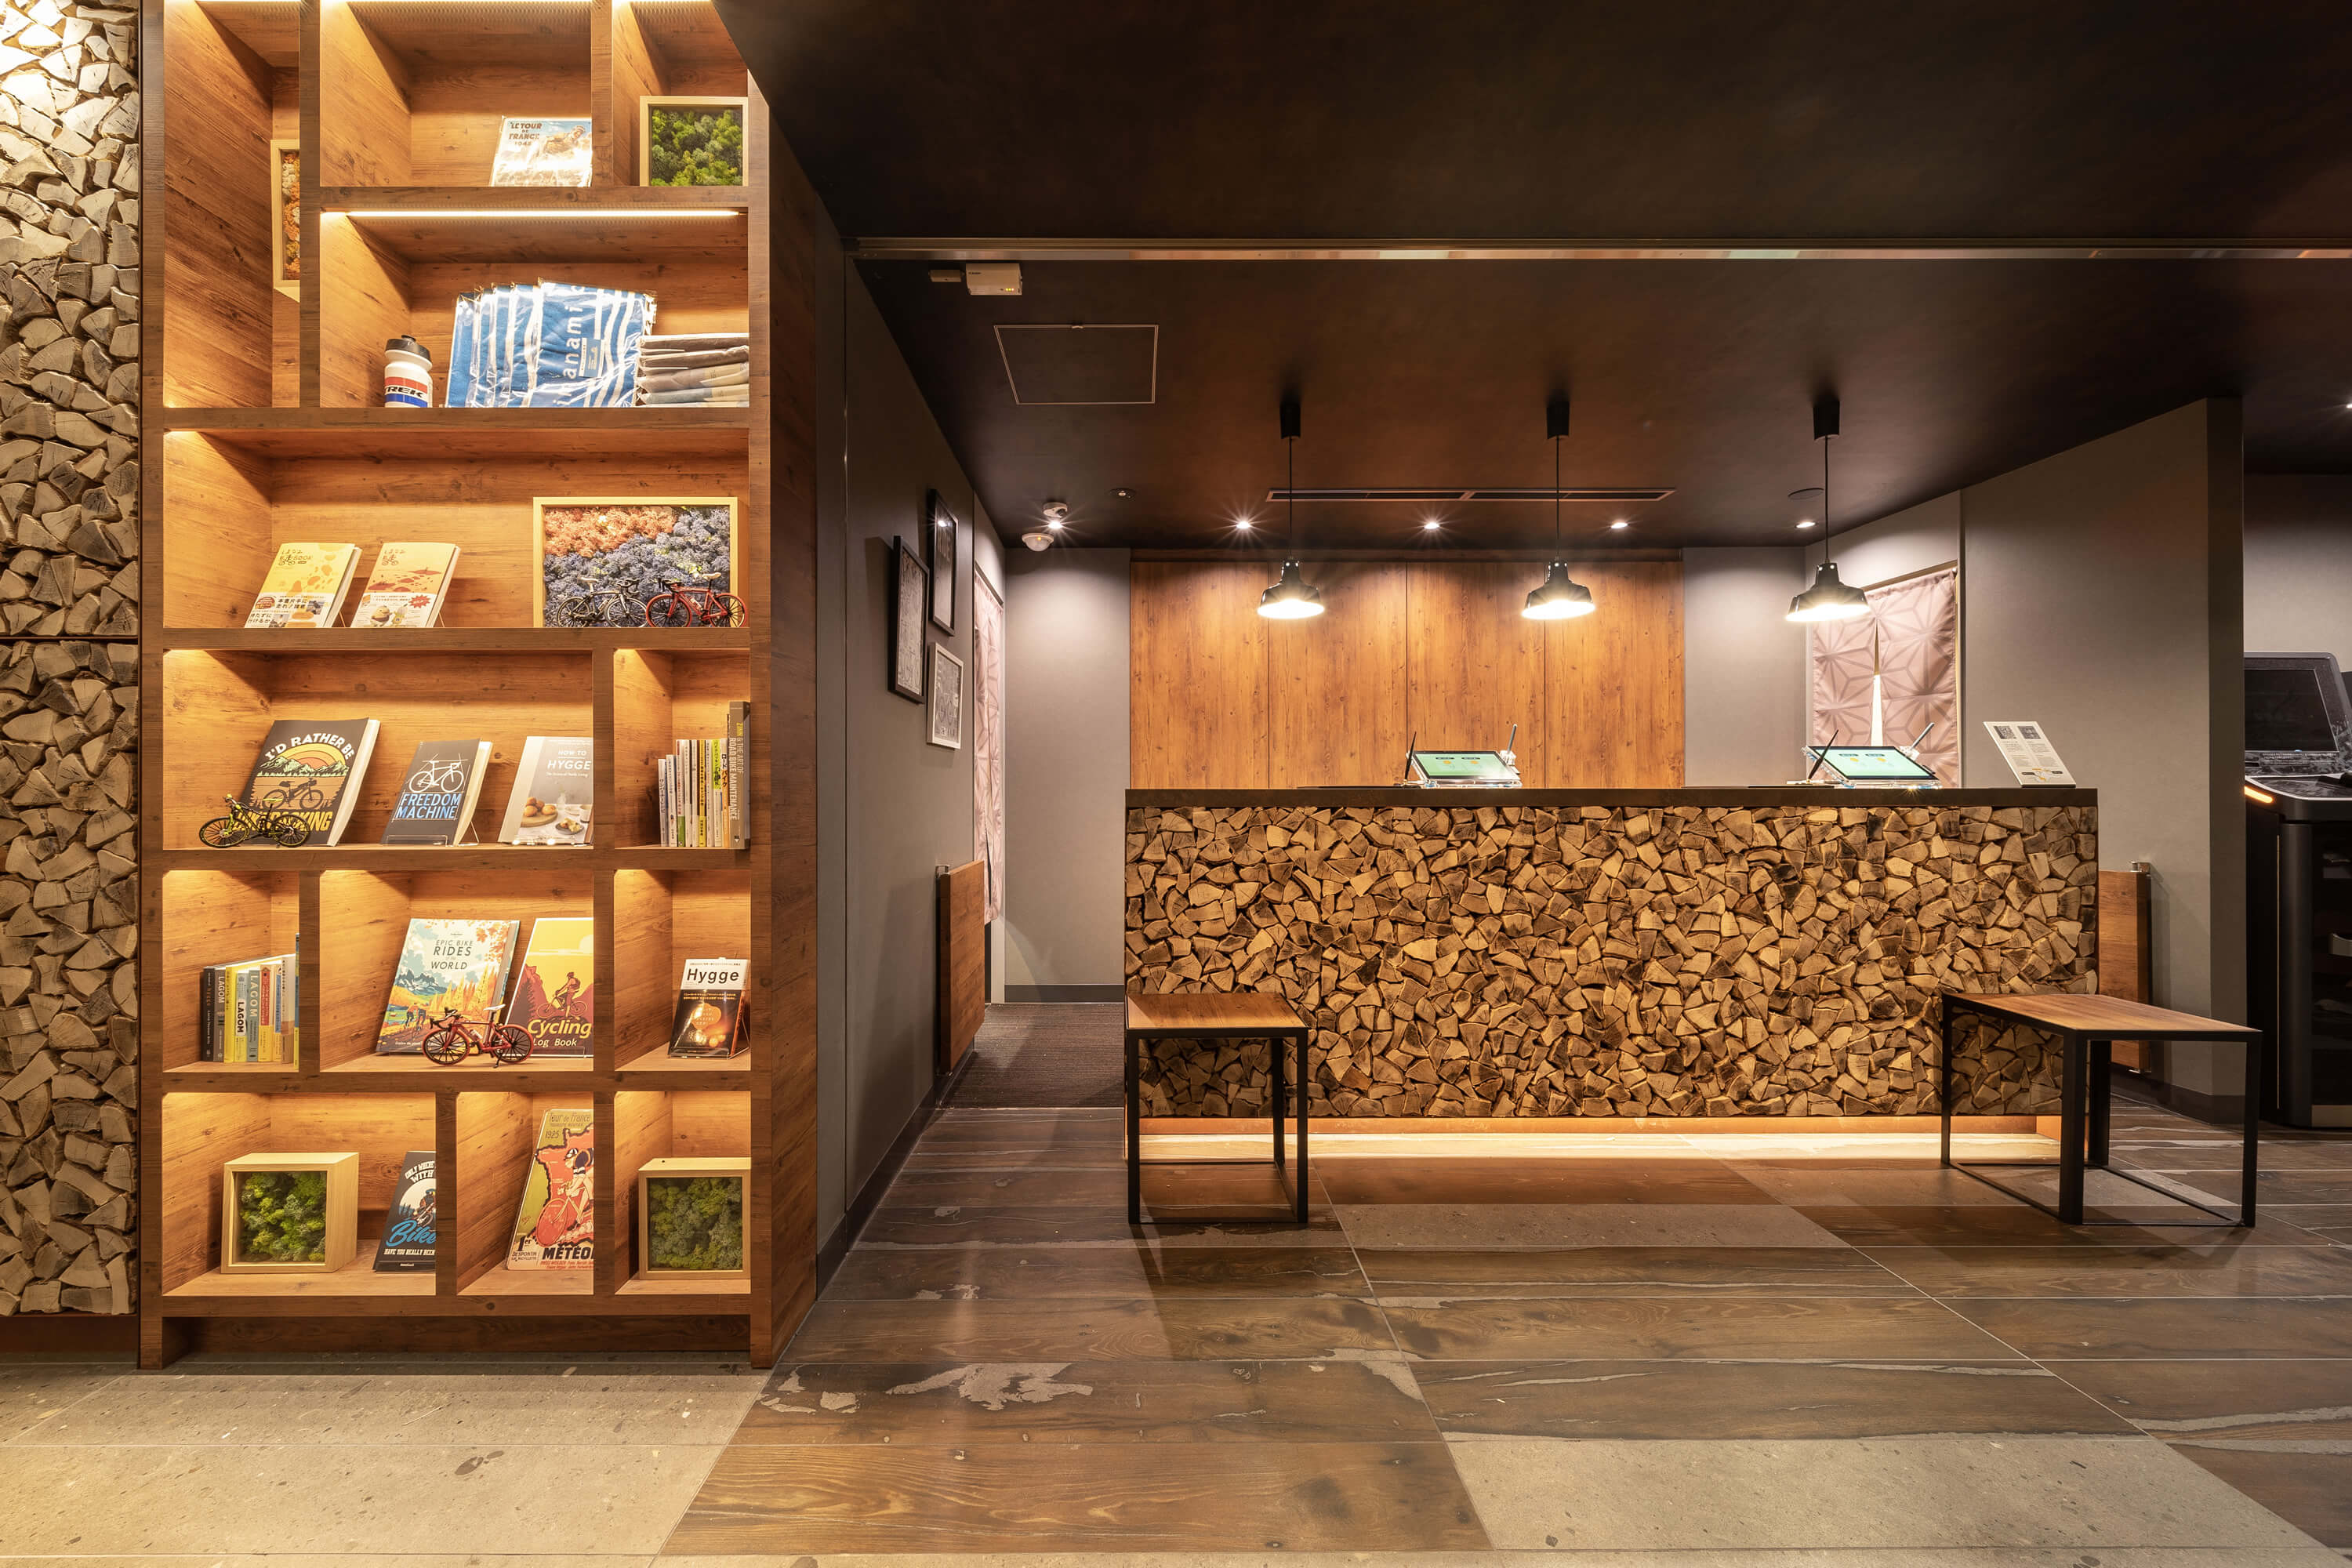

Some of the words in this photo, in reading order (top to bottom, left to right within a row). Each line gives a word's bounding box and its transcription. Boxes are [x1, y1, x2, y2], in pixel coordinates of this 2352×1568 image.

[265, 743, 286, 760] I'D
[291, 733, 345, 749] RATHER
[341, 743, 354, 760] BE
[547, 760, 592, 770] HYGGE
[401, 793, 462, 806] FREEDOM
[395, 806, 458, 818] MACHINE
[433, 946, 472, 956] RIDES
[687, 968, 739, 984] Hygge
[528, 1019, 592, 1039] Cycling
[533, 1038, 550, 1047] Log
[550, 1112, 563, 1122] Tour
[571, 1112, 590, 1122] France
[410, 1169, 434, 1182] WITH
[386, 1220, 436, 1247] Bike
[542, 1244, 593, 1260] MÉTÉO
